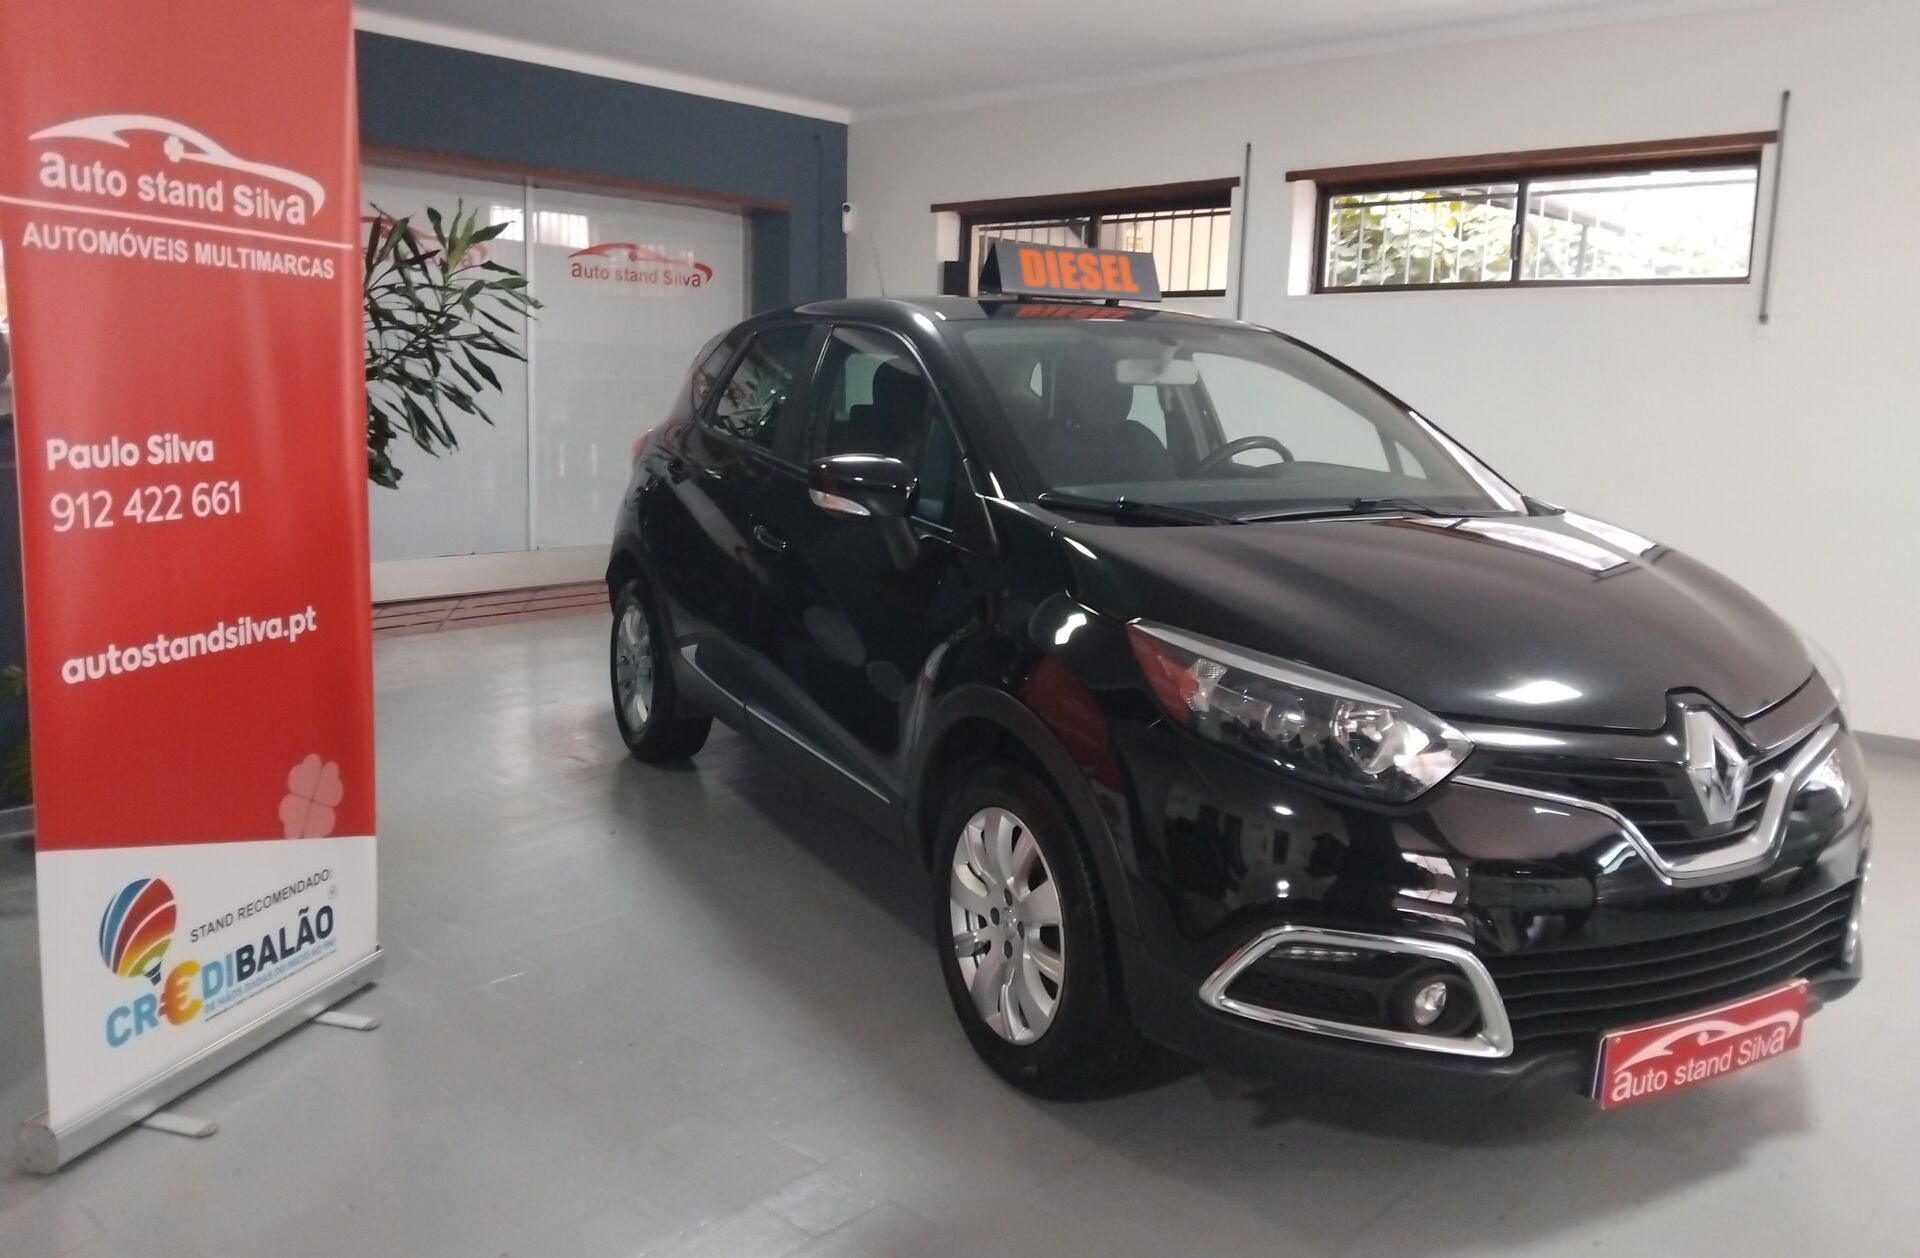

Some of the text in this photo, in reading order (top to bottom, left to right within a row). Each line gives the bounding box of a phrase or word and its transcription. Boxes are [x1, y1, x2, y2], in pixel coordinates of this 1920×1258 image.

[39, 151, 306, 226] auto stand Silva
[22, 222, 189, 264] AUTOMÓVEIS
[195, 243, 335, 280] MULTIMARCAS
[571, 263, 702, 287] auto stand Silva
[1019, 248, 1140, 294] DIESEL
[46, 433, 214, 470] Paulo Silva
[50, 480, 241, 532] 912 422 661
[61, 605, 318, 684] autostandsilva.pt
[190, 913, 234, 943] STAND
[1612, 1026, 1785, 1101] auto stand Silva
